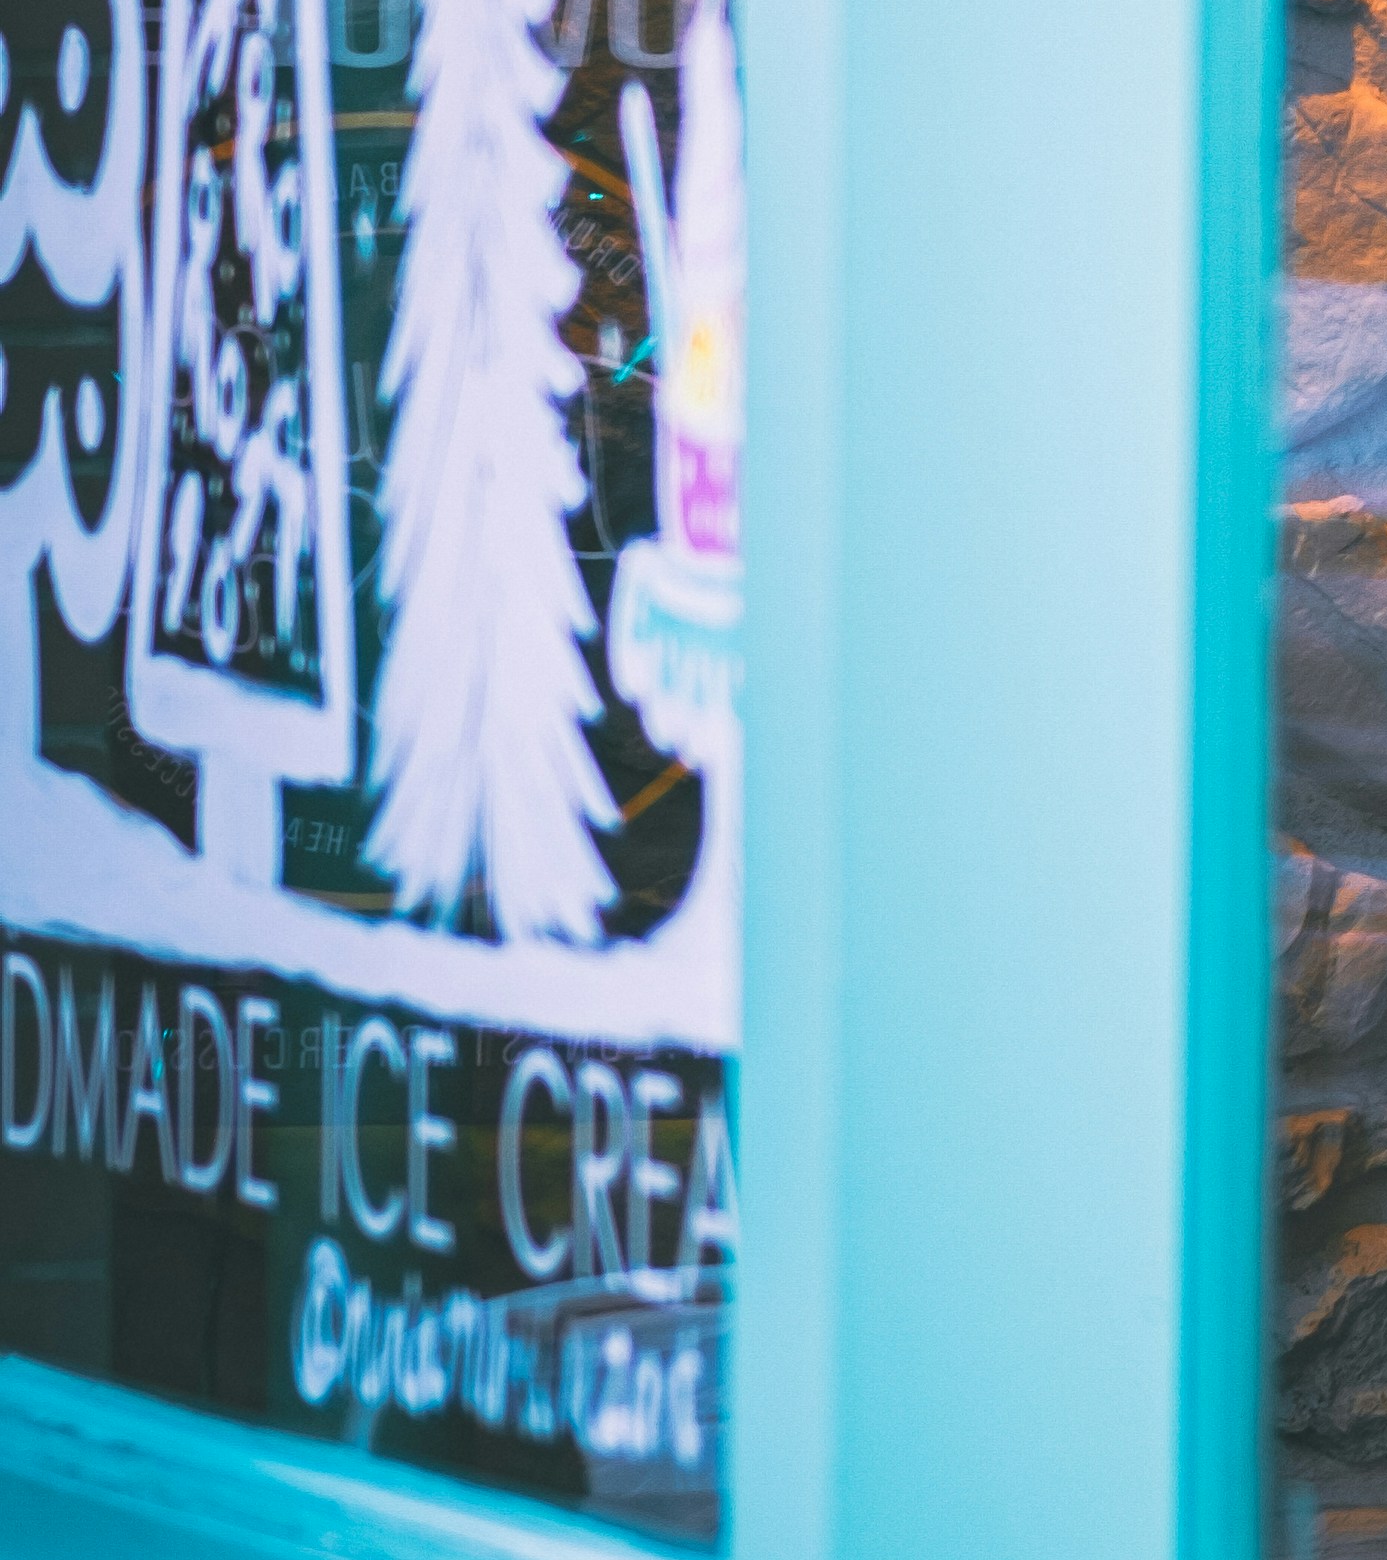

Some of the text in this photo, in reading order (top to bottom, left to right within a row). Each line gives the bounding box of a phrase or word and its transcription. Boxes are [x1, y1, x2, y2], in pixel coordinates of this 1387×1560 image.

[2, 950, 738, 1302] DMADE ICE CREA
